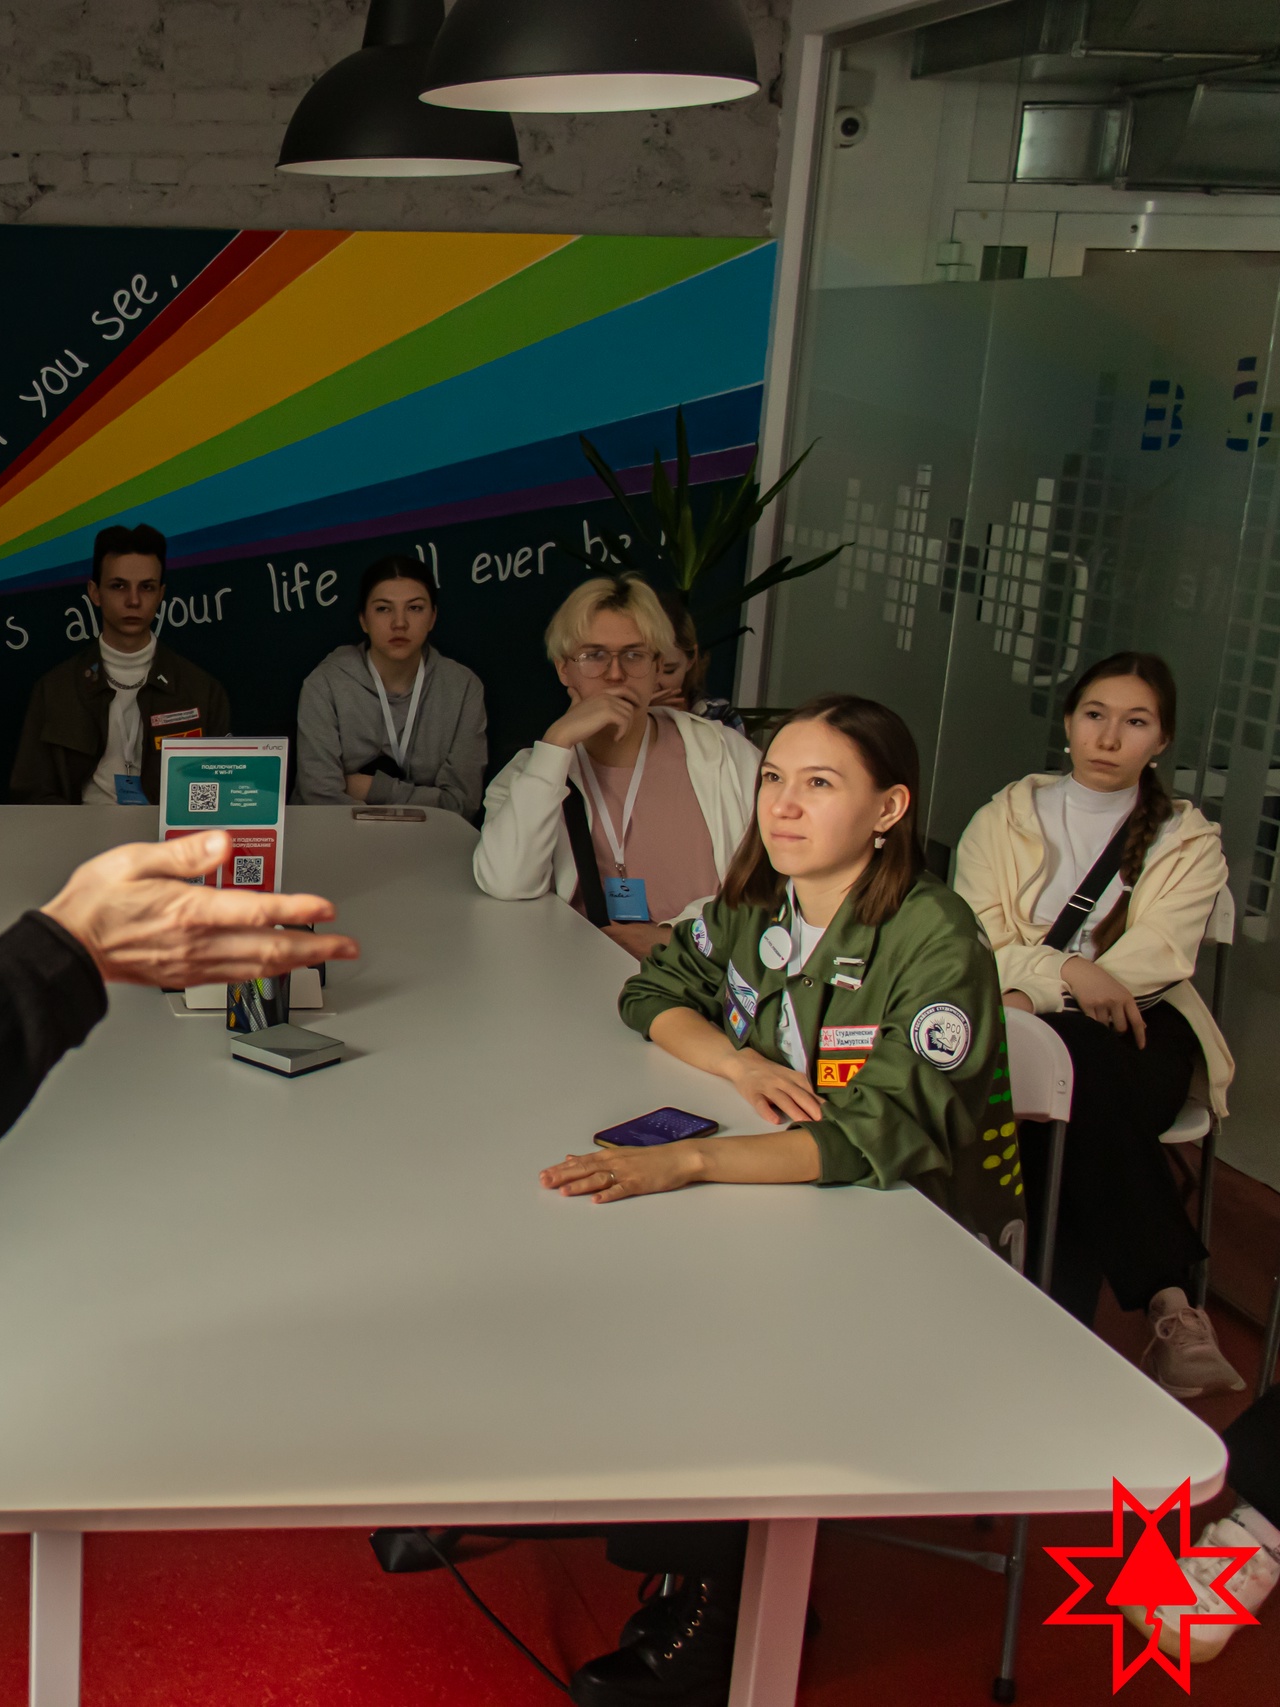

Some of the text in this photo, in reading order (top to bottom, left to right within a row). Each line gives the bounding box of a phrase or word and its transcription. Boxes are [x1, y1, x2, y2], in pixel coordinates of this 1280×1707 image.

[19, 349, 90, 418] you
[64, 594, 100, 642] al
[267, 562, 339, 613] life
[471, 540, 556, 584] ever
